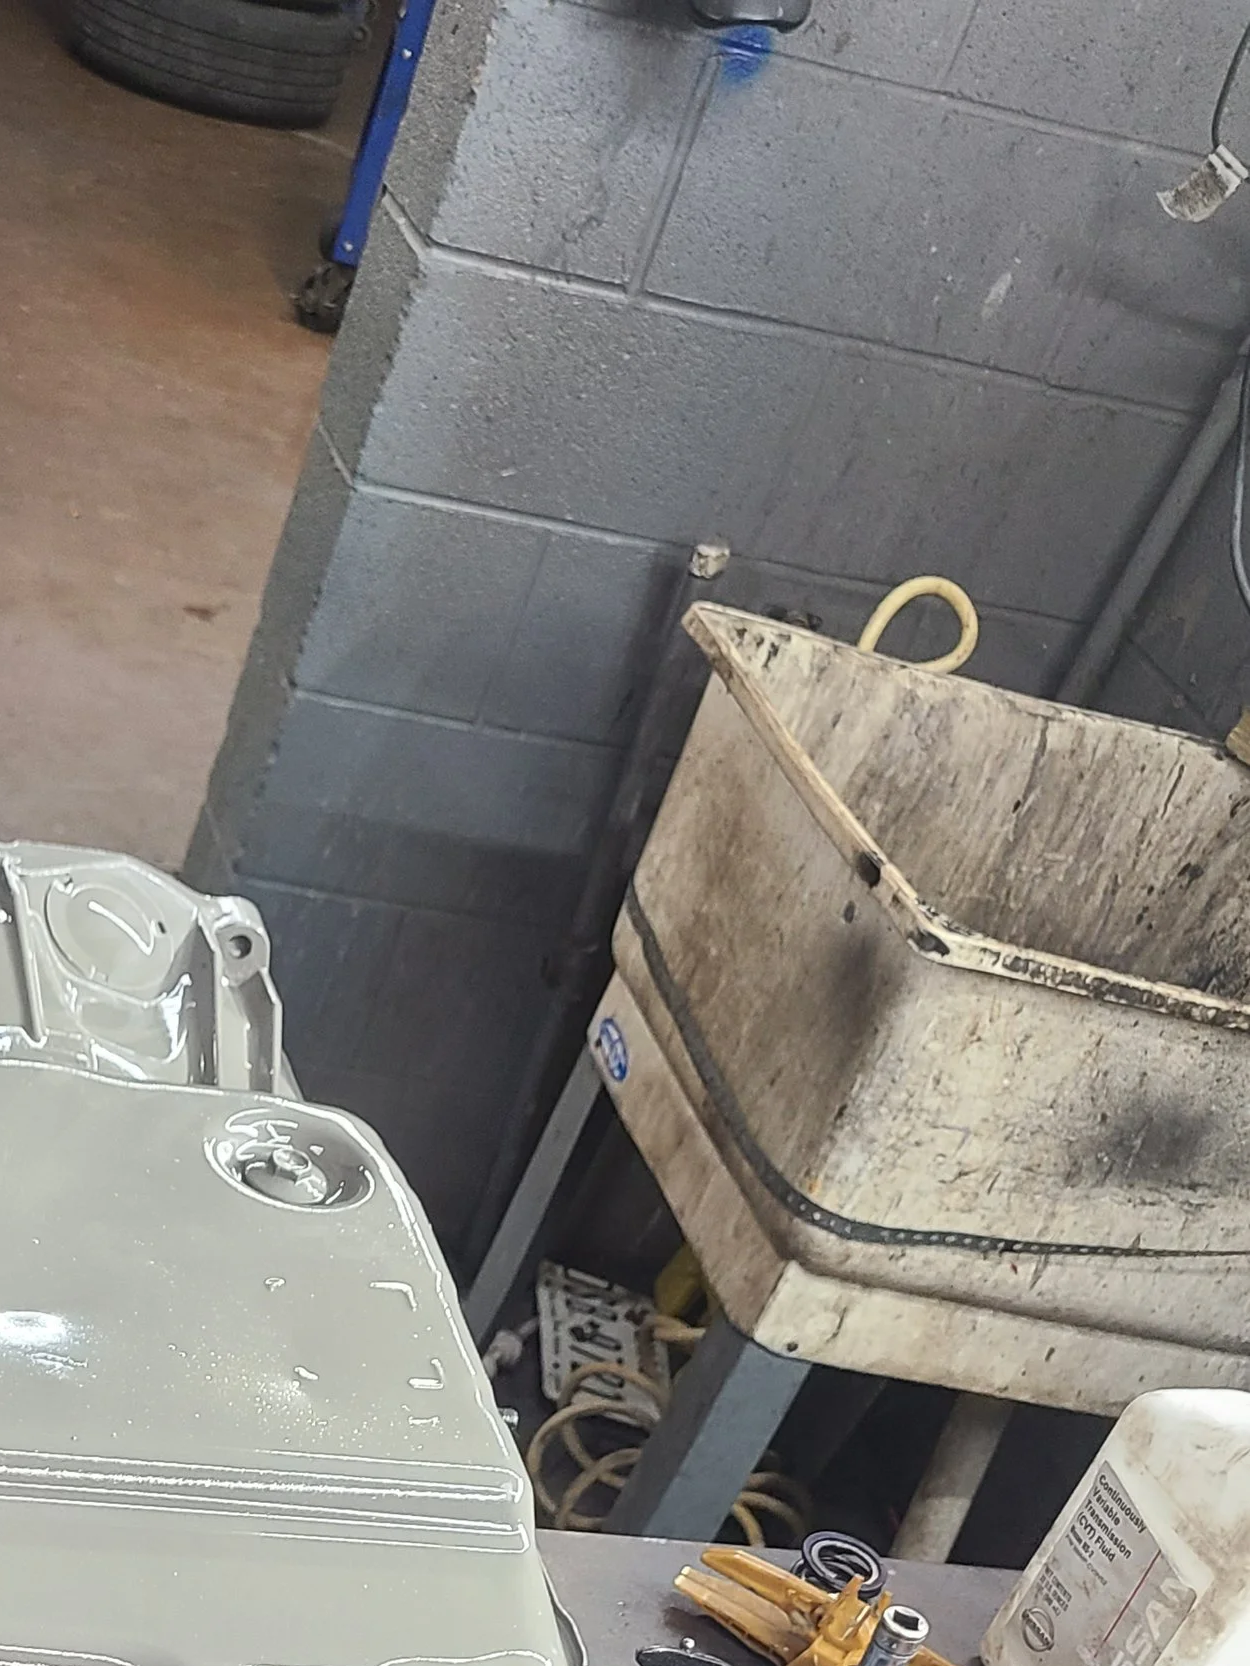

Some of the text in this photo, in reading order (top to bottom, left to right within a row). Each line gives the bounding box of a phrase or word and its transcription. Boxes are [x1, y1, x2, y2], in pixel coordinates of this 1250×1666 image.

[1085, 1500, 1132, 1559] Transmission
[1093, 1487, 1120, 1526] Variable
[1099, 1475, 1146, 1533] Continuously
[1077, 1512, 1095, 1540] (CVT)
[1095, 1535, 1116, 1562] Fluid
